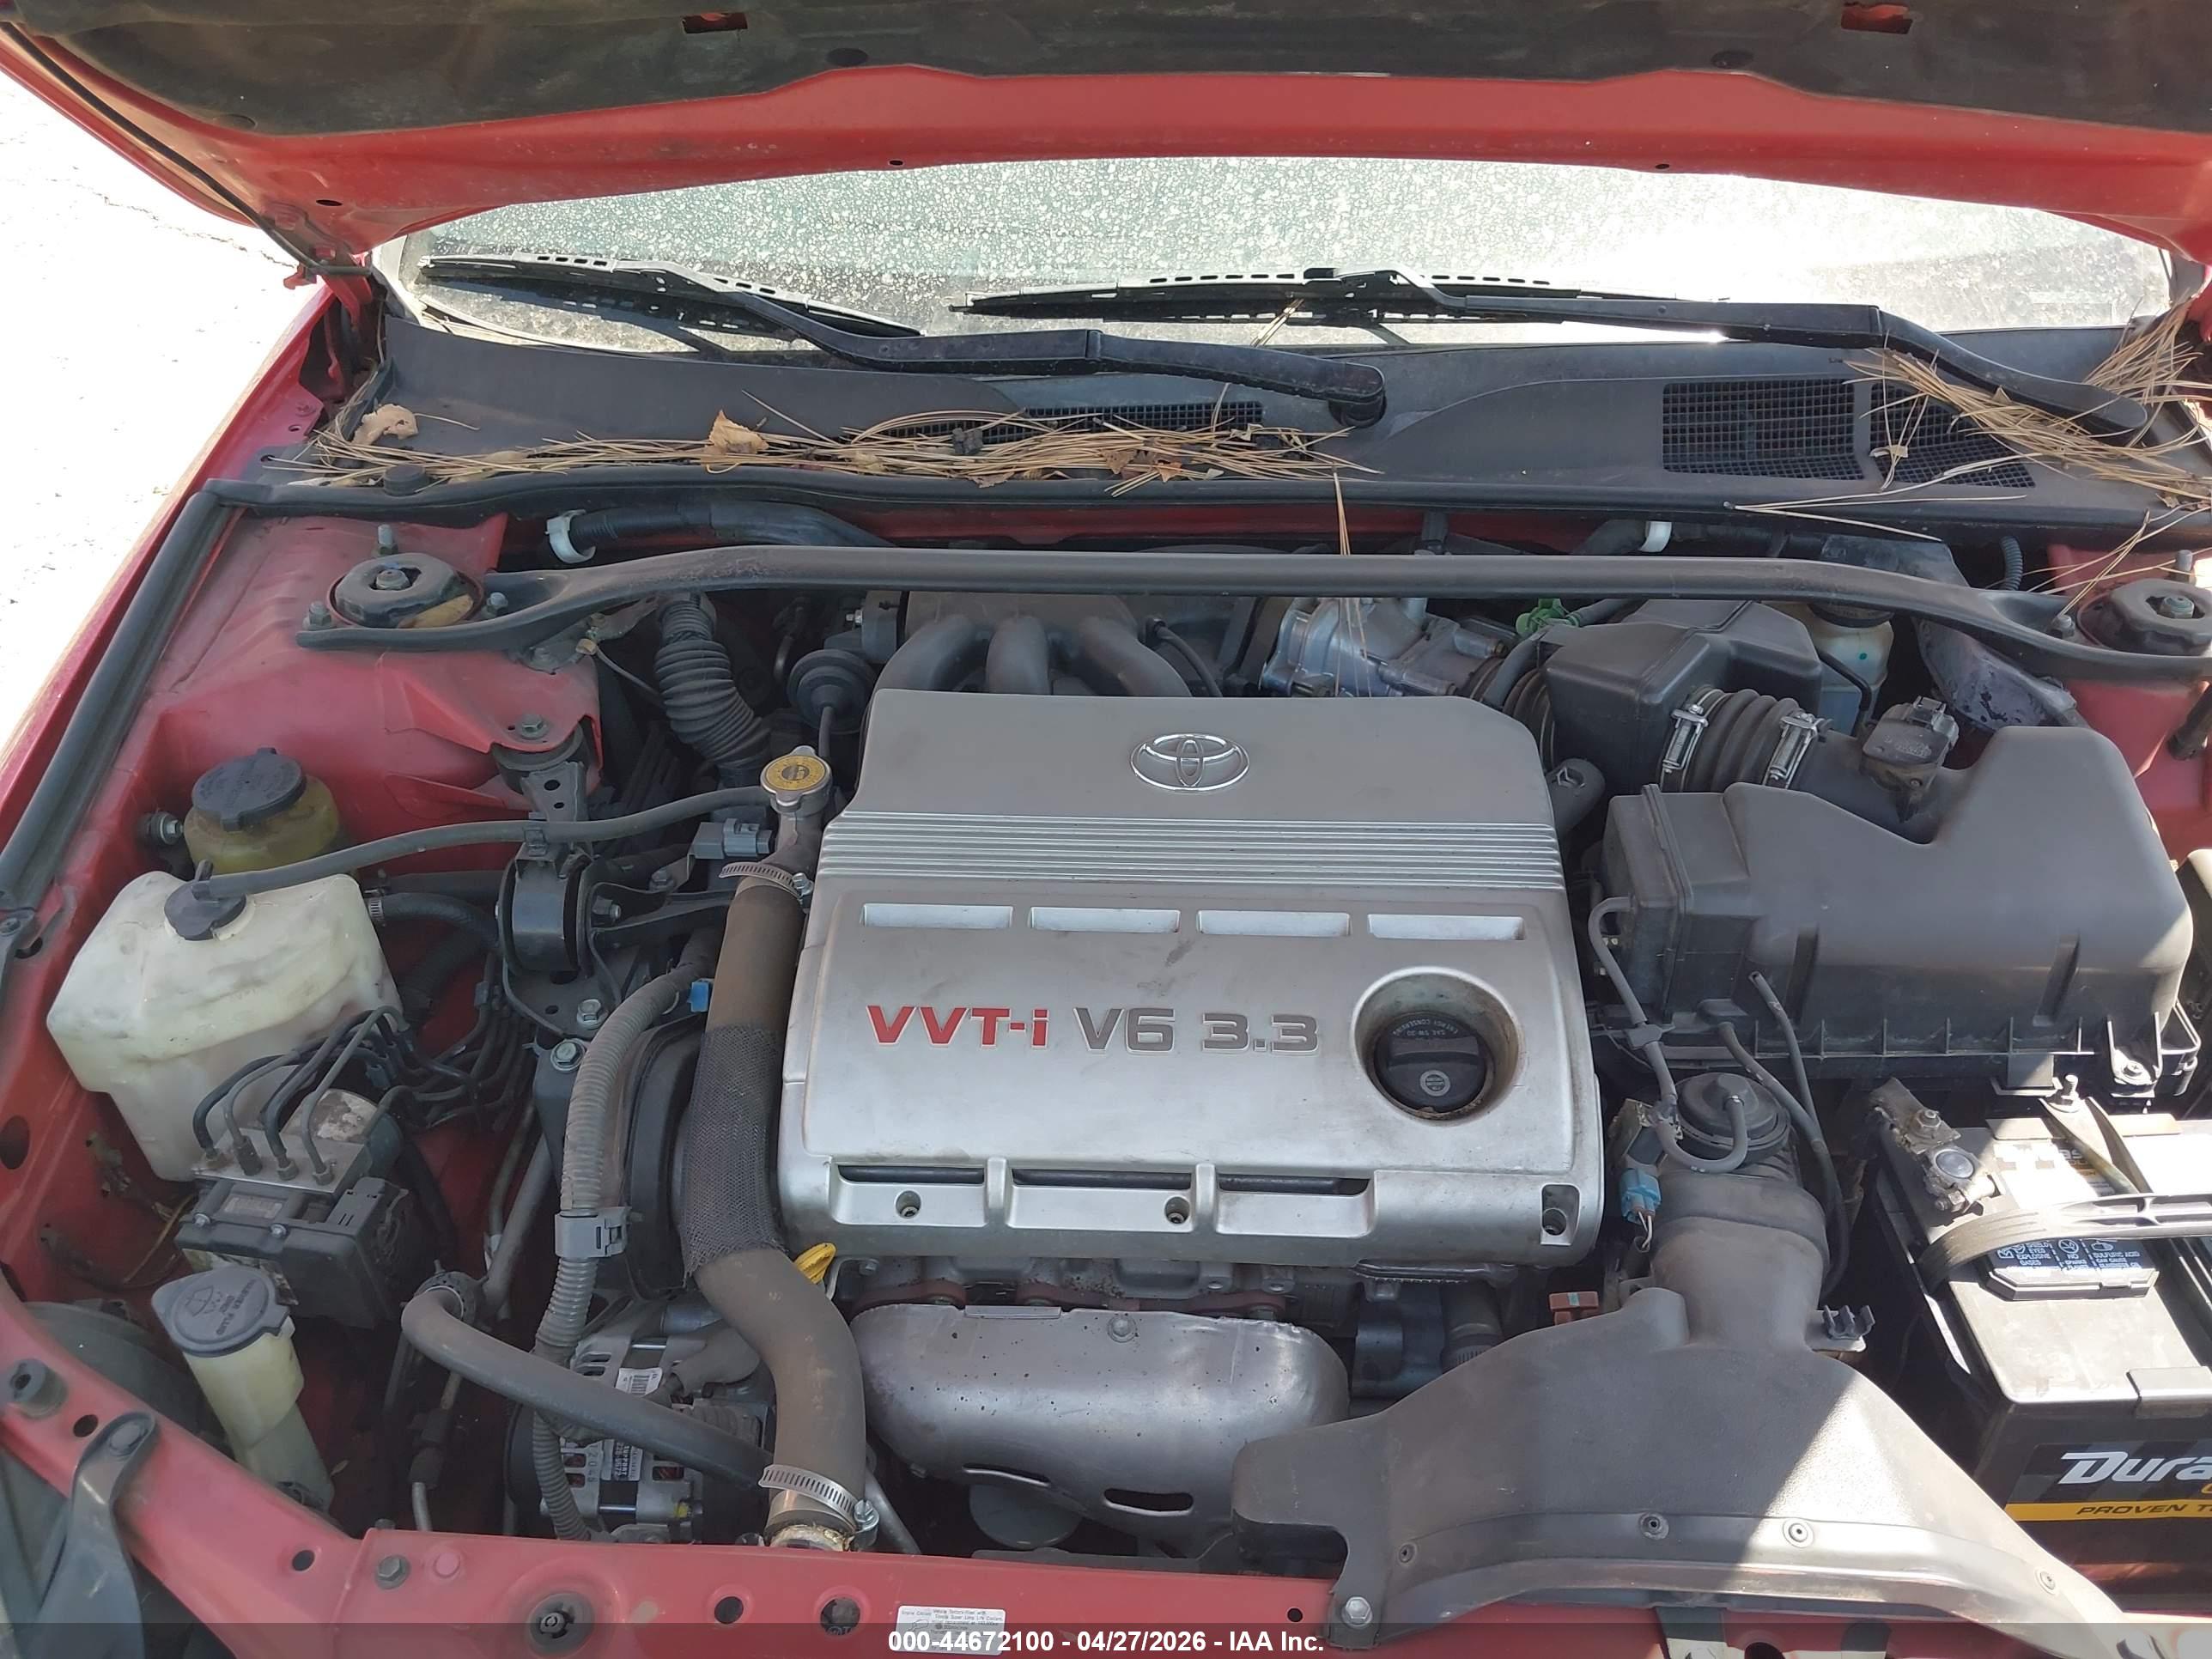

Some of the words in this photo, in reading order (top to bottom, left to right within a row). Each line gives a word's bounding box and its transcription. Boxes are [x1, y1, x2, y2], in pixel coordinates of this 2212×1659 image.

[866, 1004, 1049, 1048] VVT-i
[1073, 1006, 1176, 1054] V6
[1202, 1012, 1320, 1056] 3.3
[2076, 1504, 2188, 1516] PROVEN
